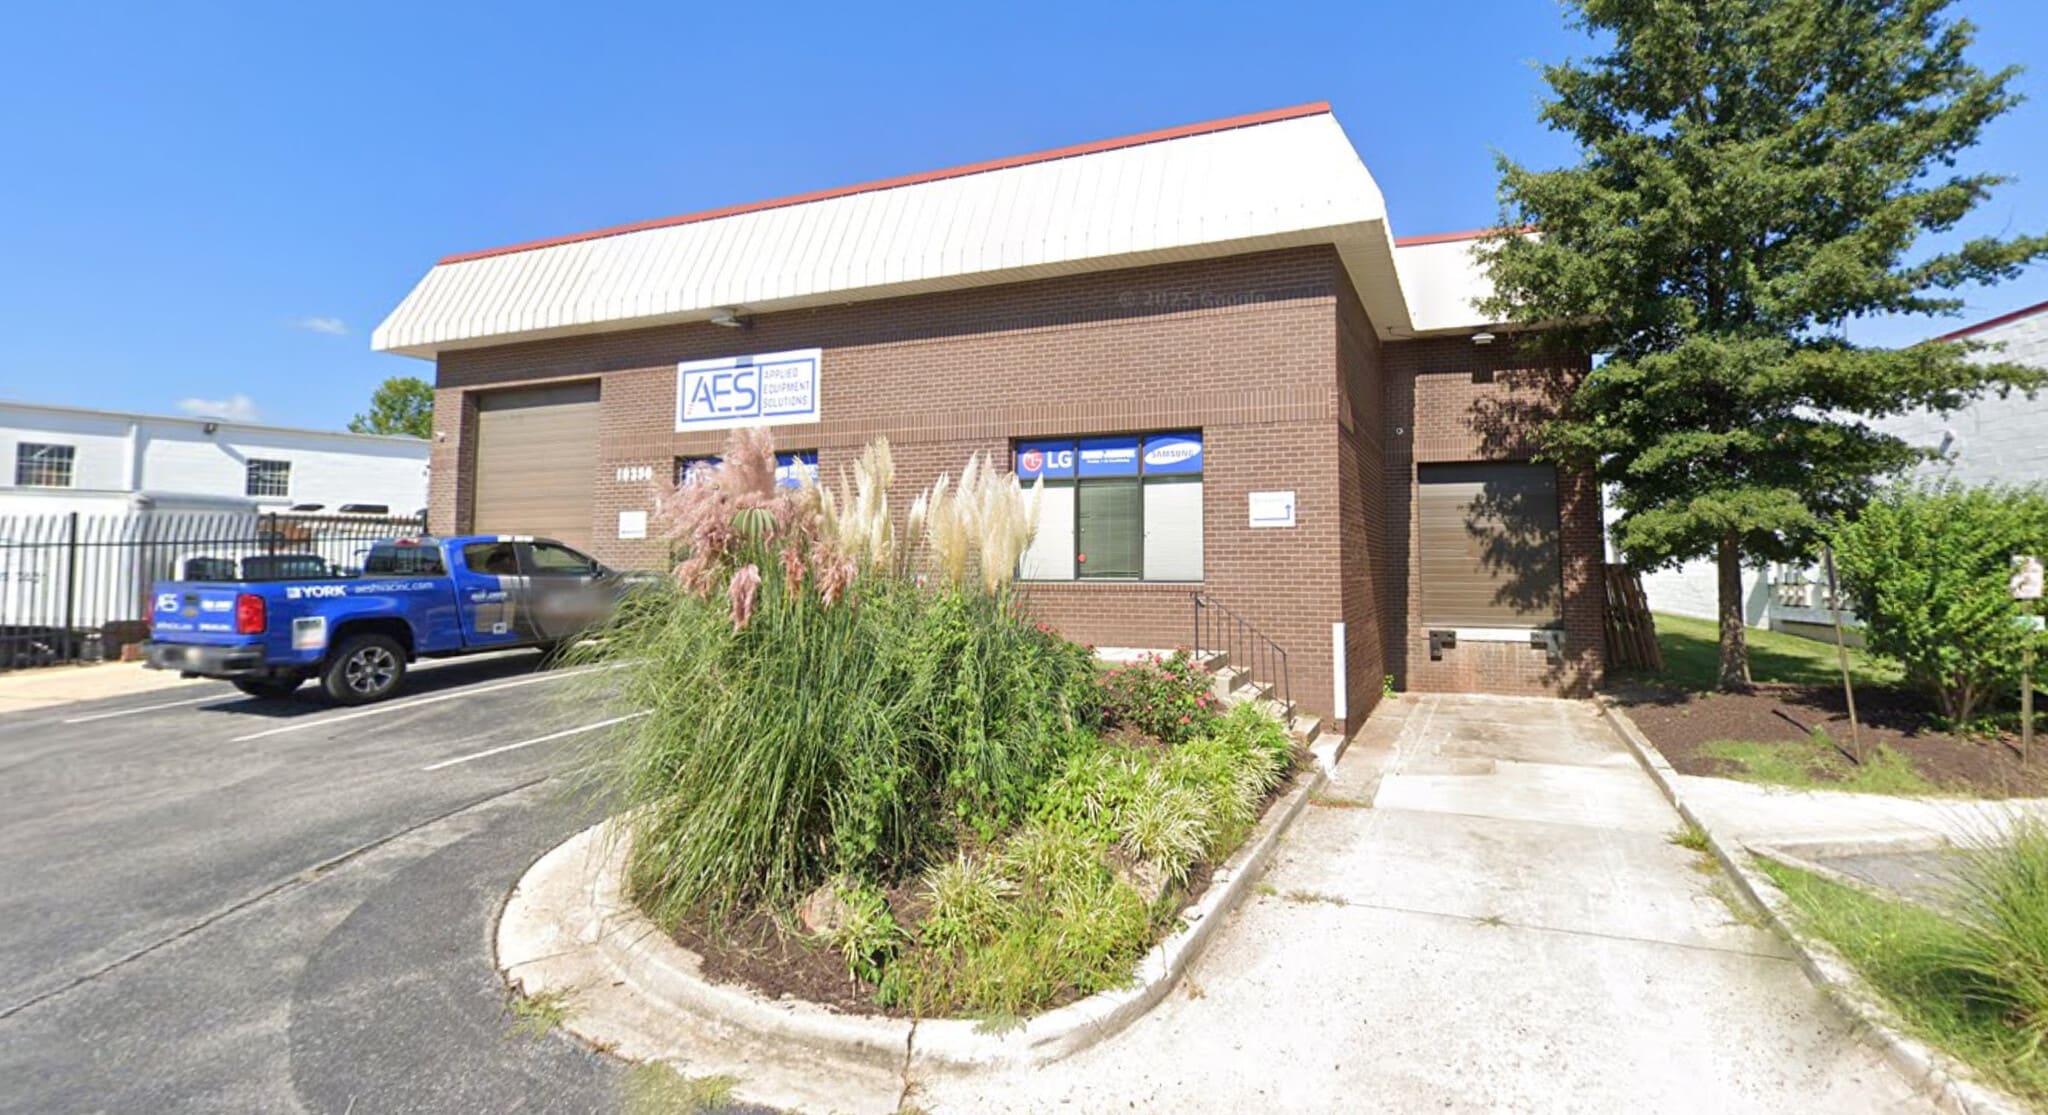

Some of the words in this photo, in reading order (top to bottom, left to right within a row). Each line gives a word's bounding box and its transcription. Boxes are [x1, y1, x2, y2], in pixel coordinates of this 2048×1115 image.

[763, 367, 799, 379] APPLIED
[690, 371, 756, 413] AES
[763, 380, 810, 394] EQUIPMENT
[763, 395, 808, 408] SOLUTIONS
[1047, 450, 1073, 468] LG
[1151, 450, 1195, 459] SAMSUNG
[301, 584, 347, 598] YORK
